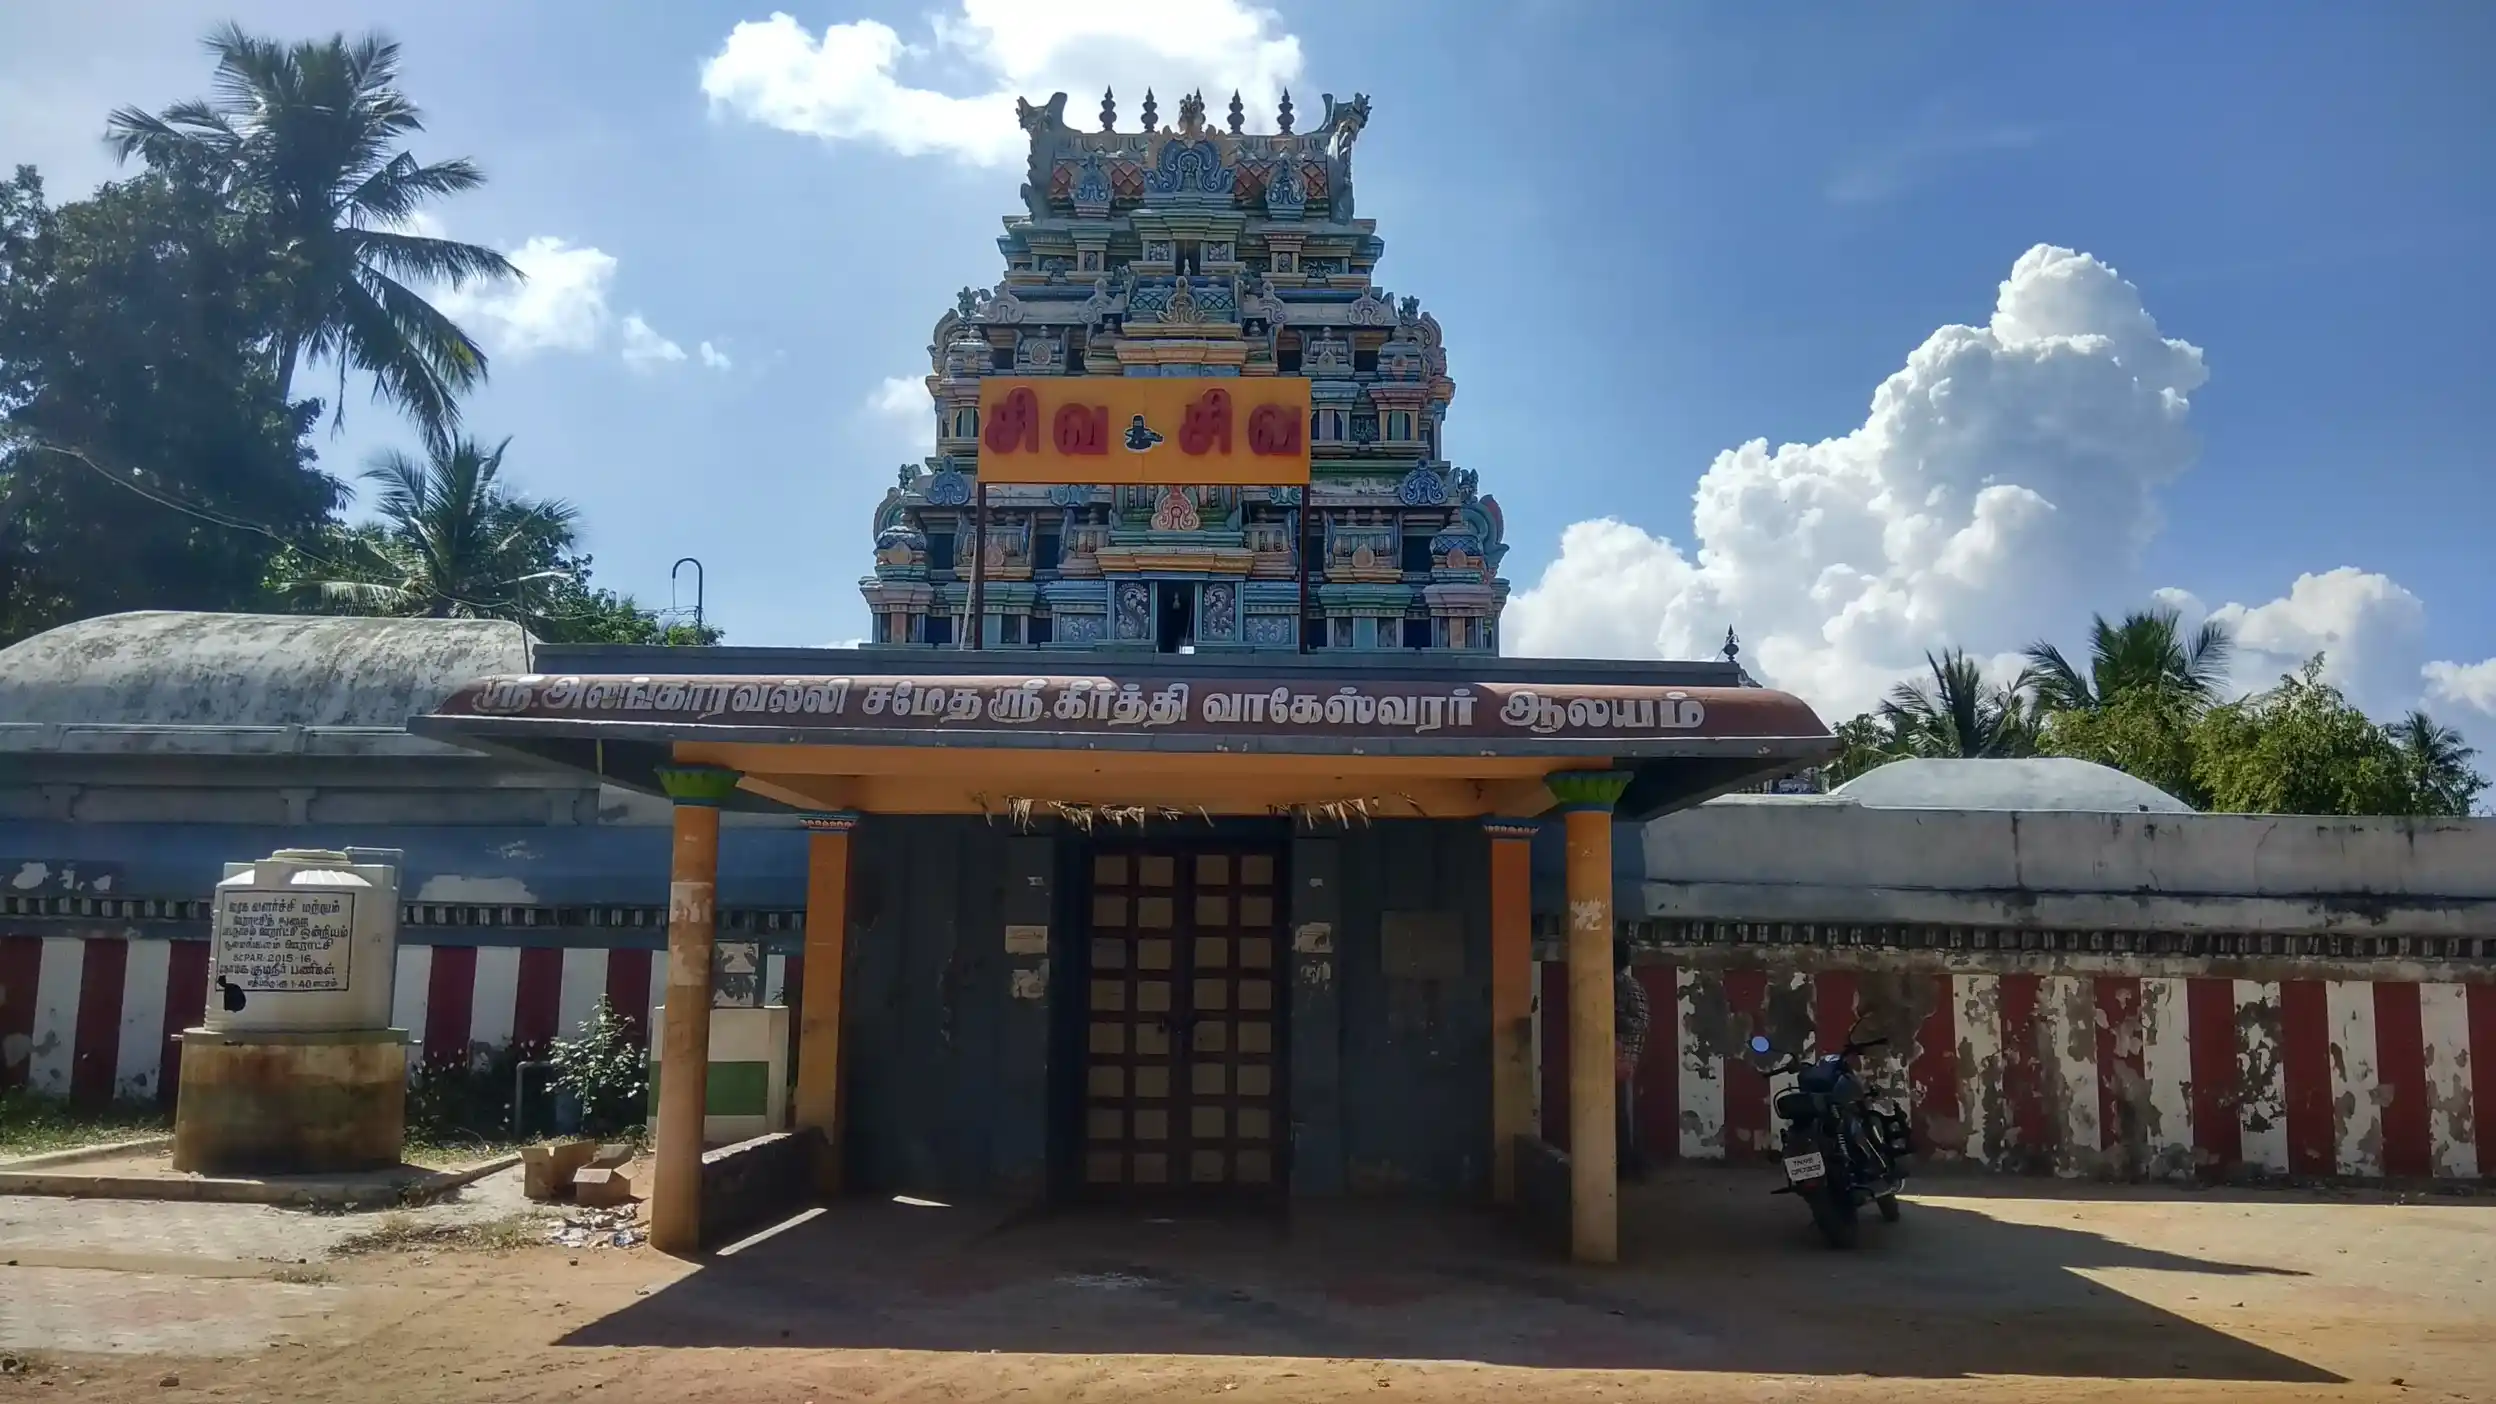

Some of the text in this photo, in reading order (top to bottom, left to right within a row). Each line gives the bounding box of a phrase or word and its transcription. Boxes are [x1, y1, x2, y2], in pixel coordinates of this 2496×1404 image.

[984, 386, 1302, 456] சிவ சிவ
[1202, 686, 1478, 735] வாகேஸ்வரர்
[1499, 690, 1705, 734] ஆலயம்
